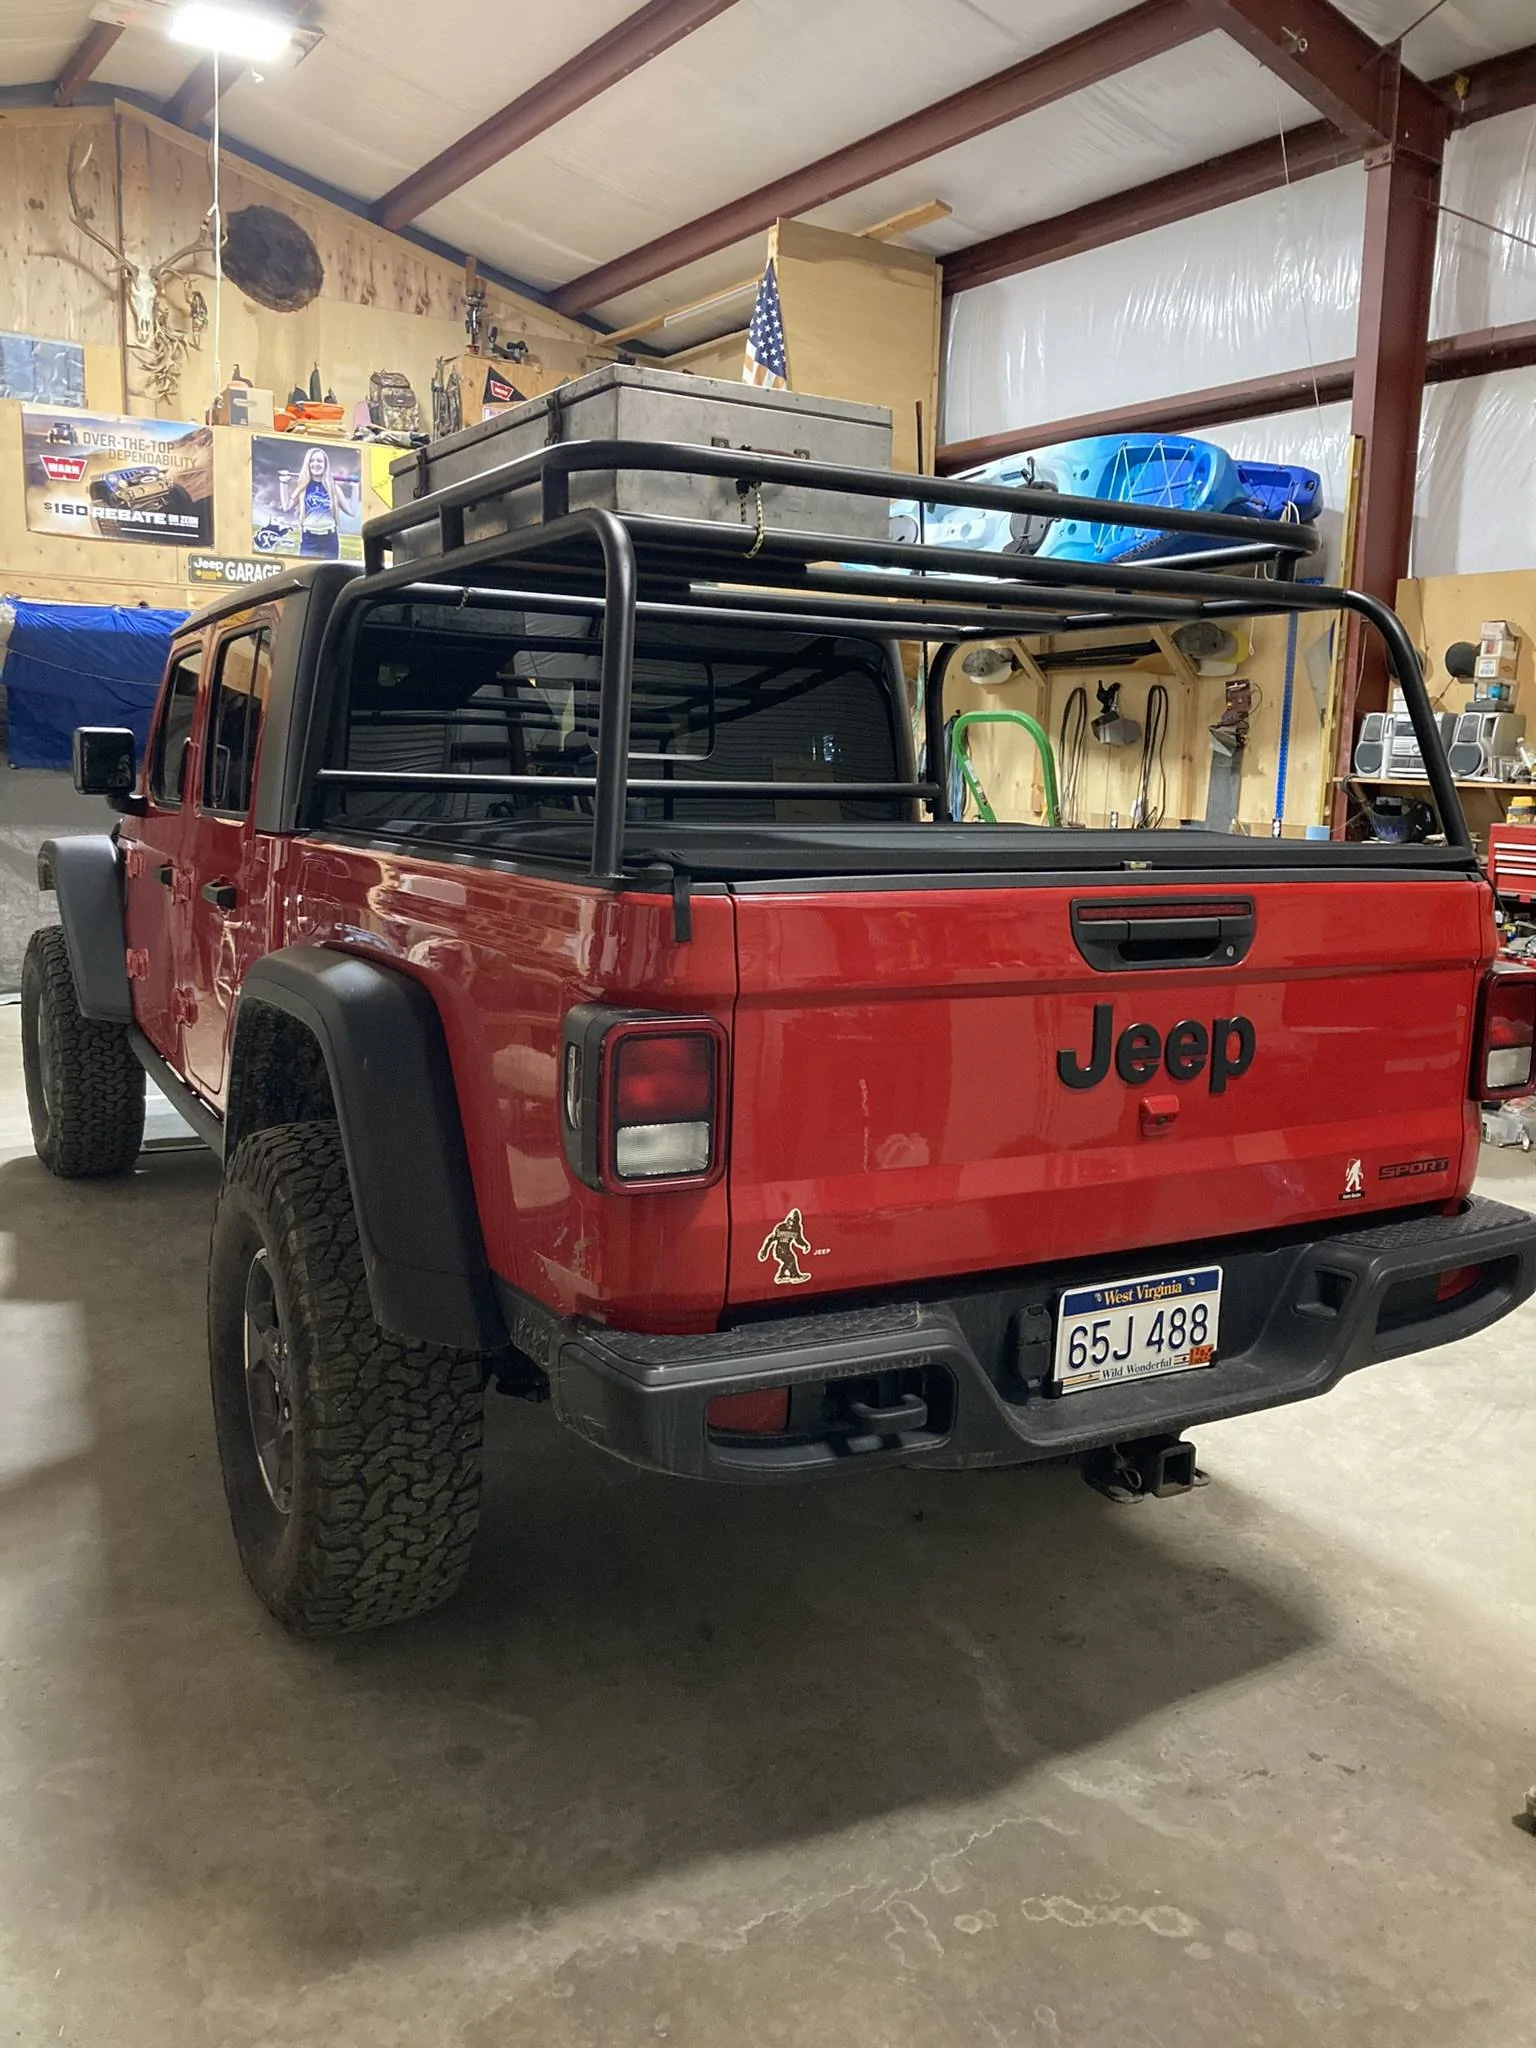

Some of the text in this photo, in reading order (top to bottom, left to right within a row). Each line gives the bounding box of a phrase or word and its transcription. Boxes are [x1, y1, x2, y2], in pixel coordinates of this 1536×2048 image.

[83, 431, 175, 454] OVER-THE-TOP
[48, 462, 80, 476] WARN
[108, 448, 197, 468] DEPENDABILITY
[43, 502, 88, 516] $150
[92, 507, 167, 525] REBATE
[193, 557, 224, 571] Jeep
[1056, 1003, 1257, 1095] Jeep
[1381, 1159, 1448, 1177] SPORT
[813, 1248, 832, 1256] JEEP
[1104, 1280, 1183, 1306] West Virginia
[1068, 1303, 1209, 1369] 65J 488
[1102, 1357, 1172, 1379] Wild Wonderful
